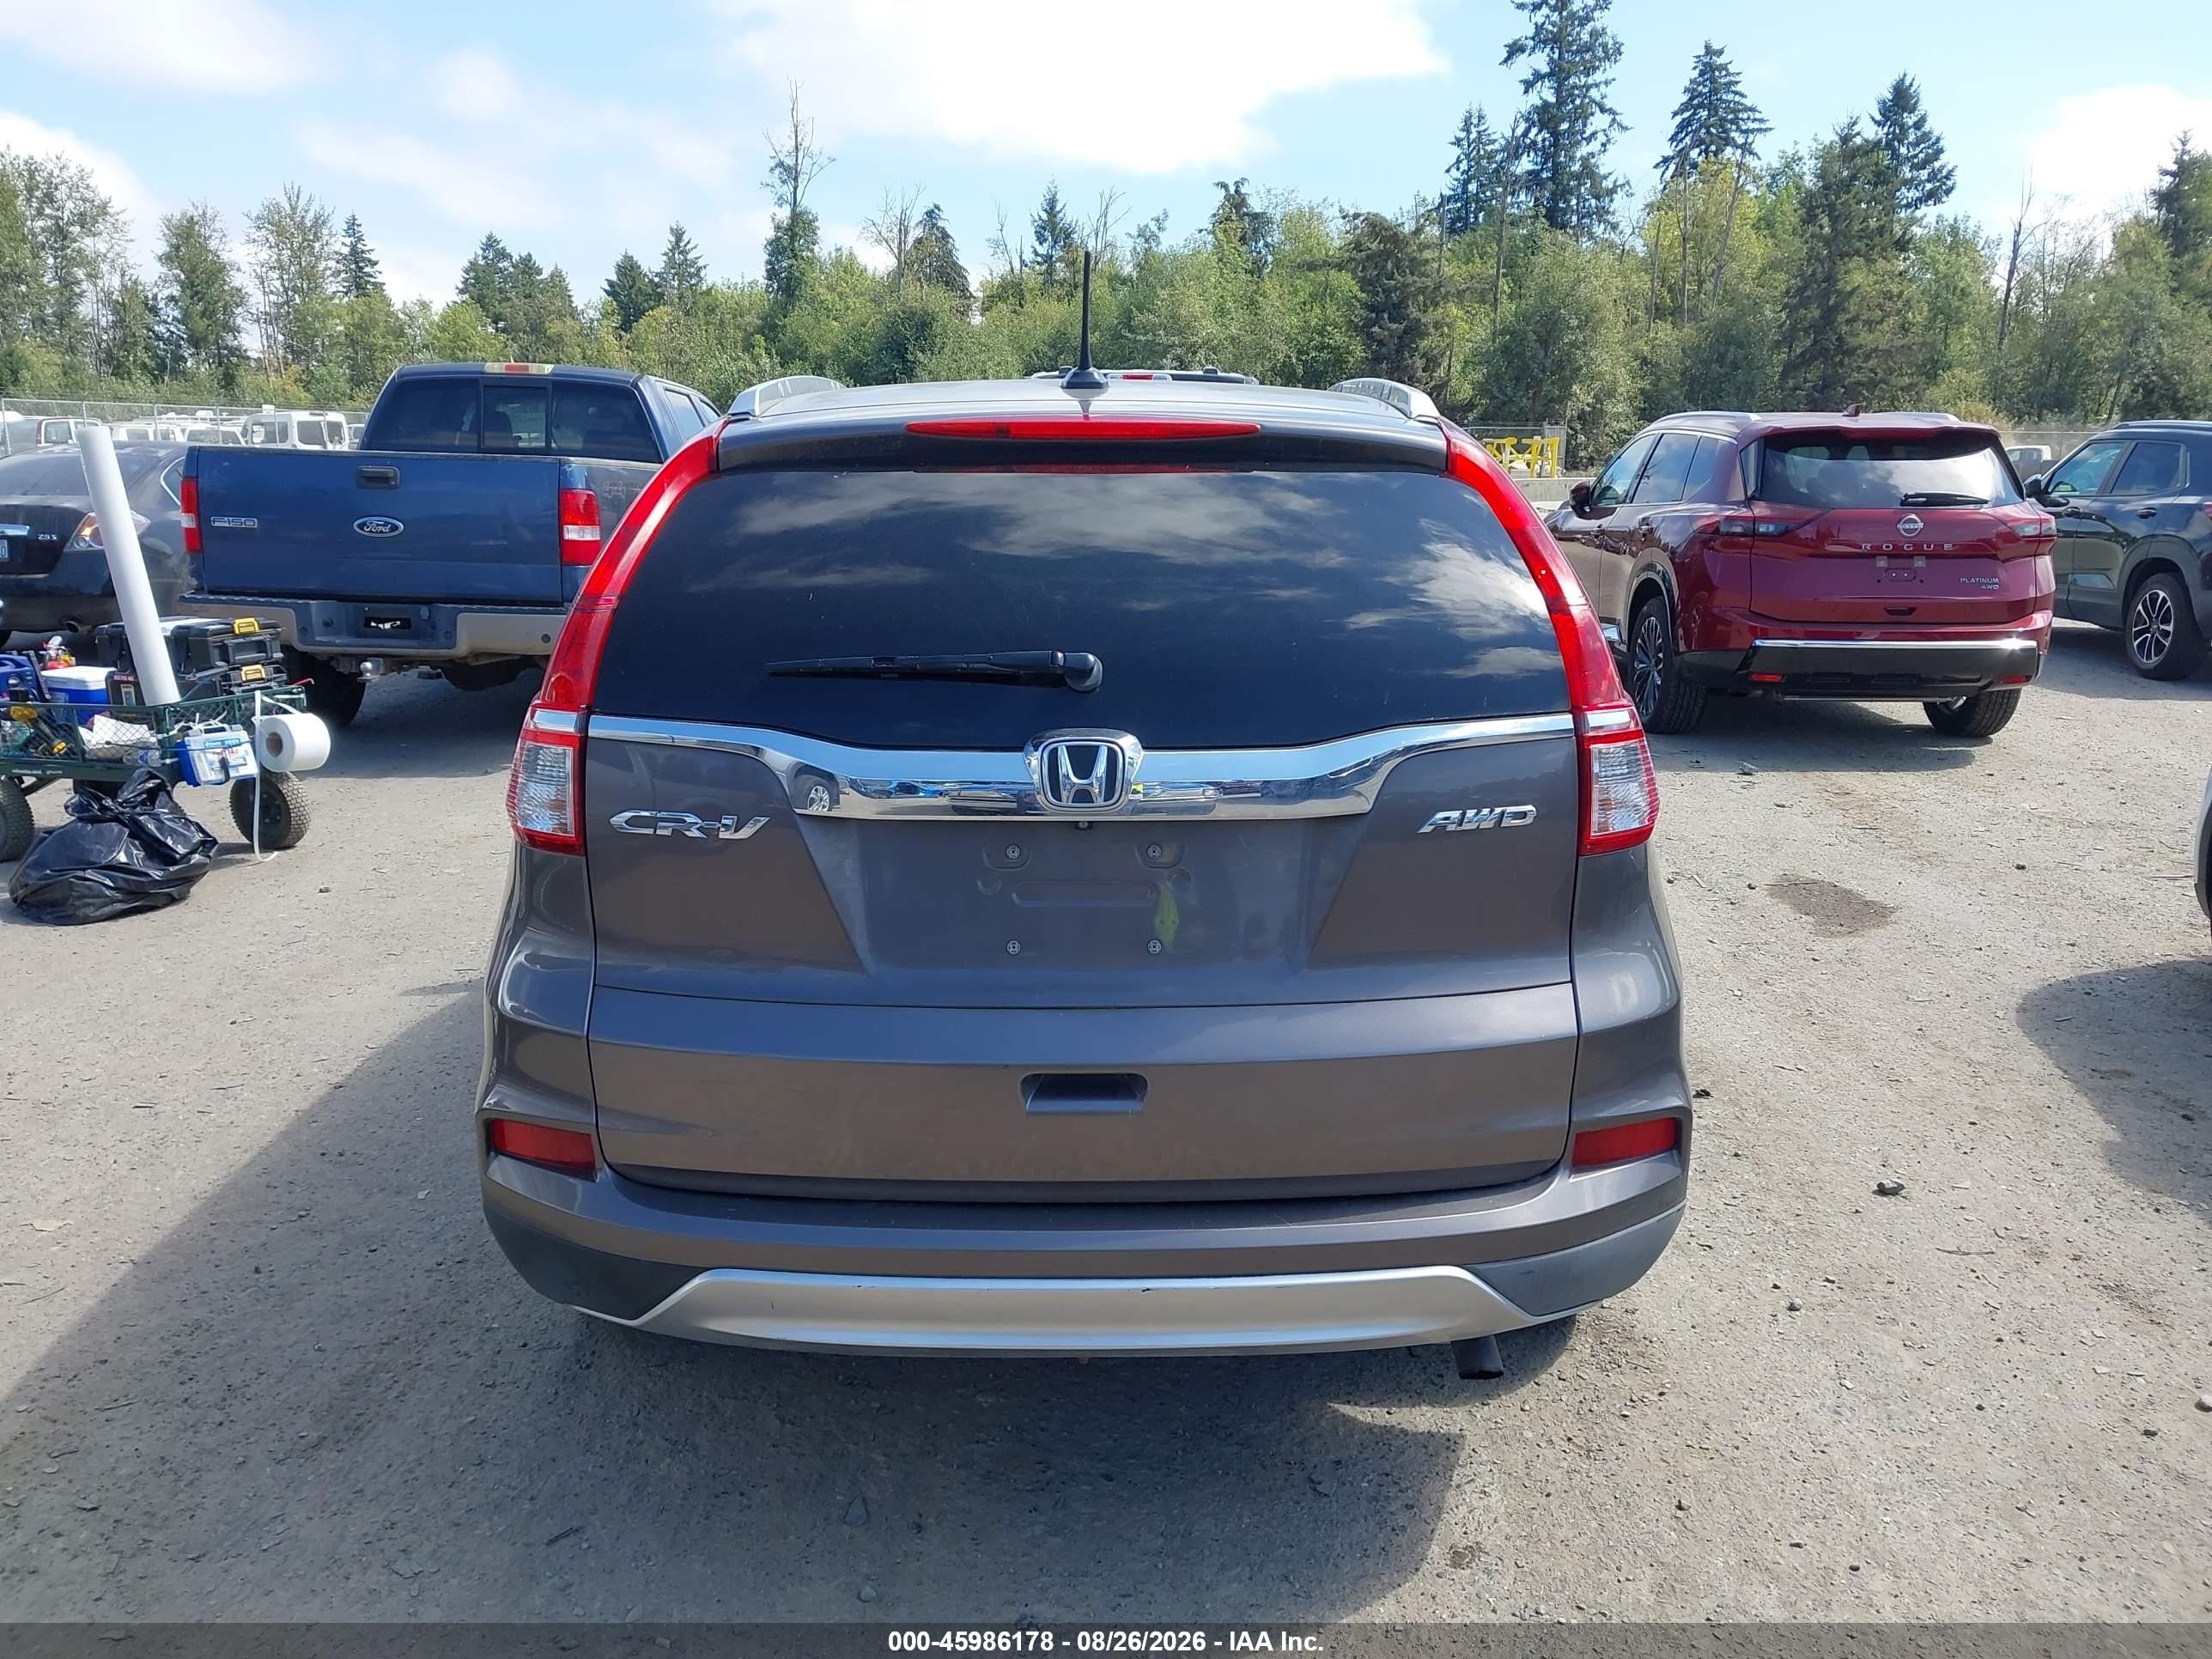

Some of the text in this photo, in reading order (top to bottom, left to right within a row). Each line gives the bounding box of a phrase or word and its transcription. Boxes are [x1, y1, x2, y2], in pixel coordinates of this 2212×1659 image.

[363, 520, 392, 532] Ford
[610, 809, 771, 840] CR-V
[1417, 805, 1537, 833] AWD
